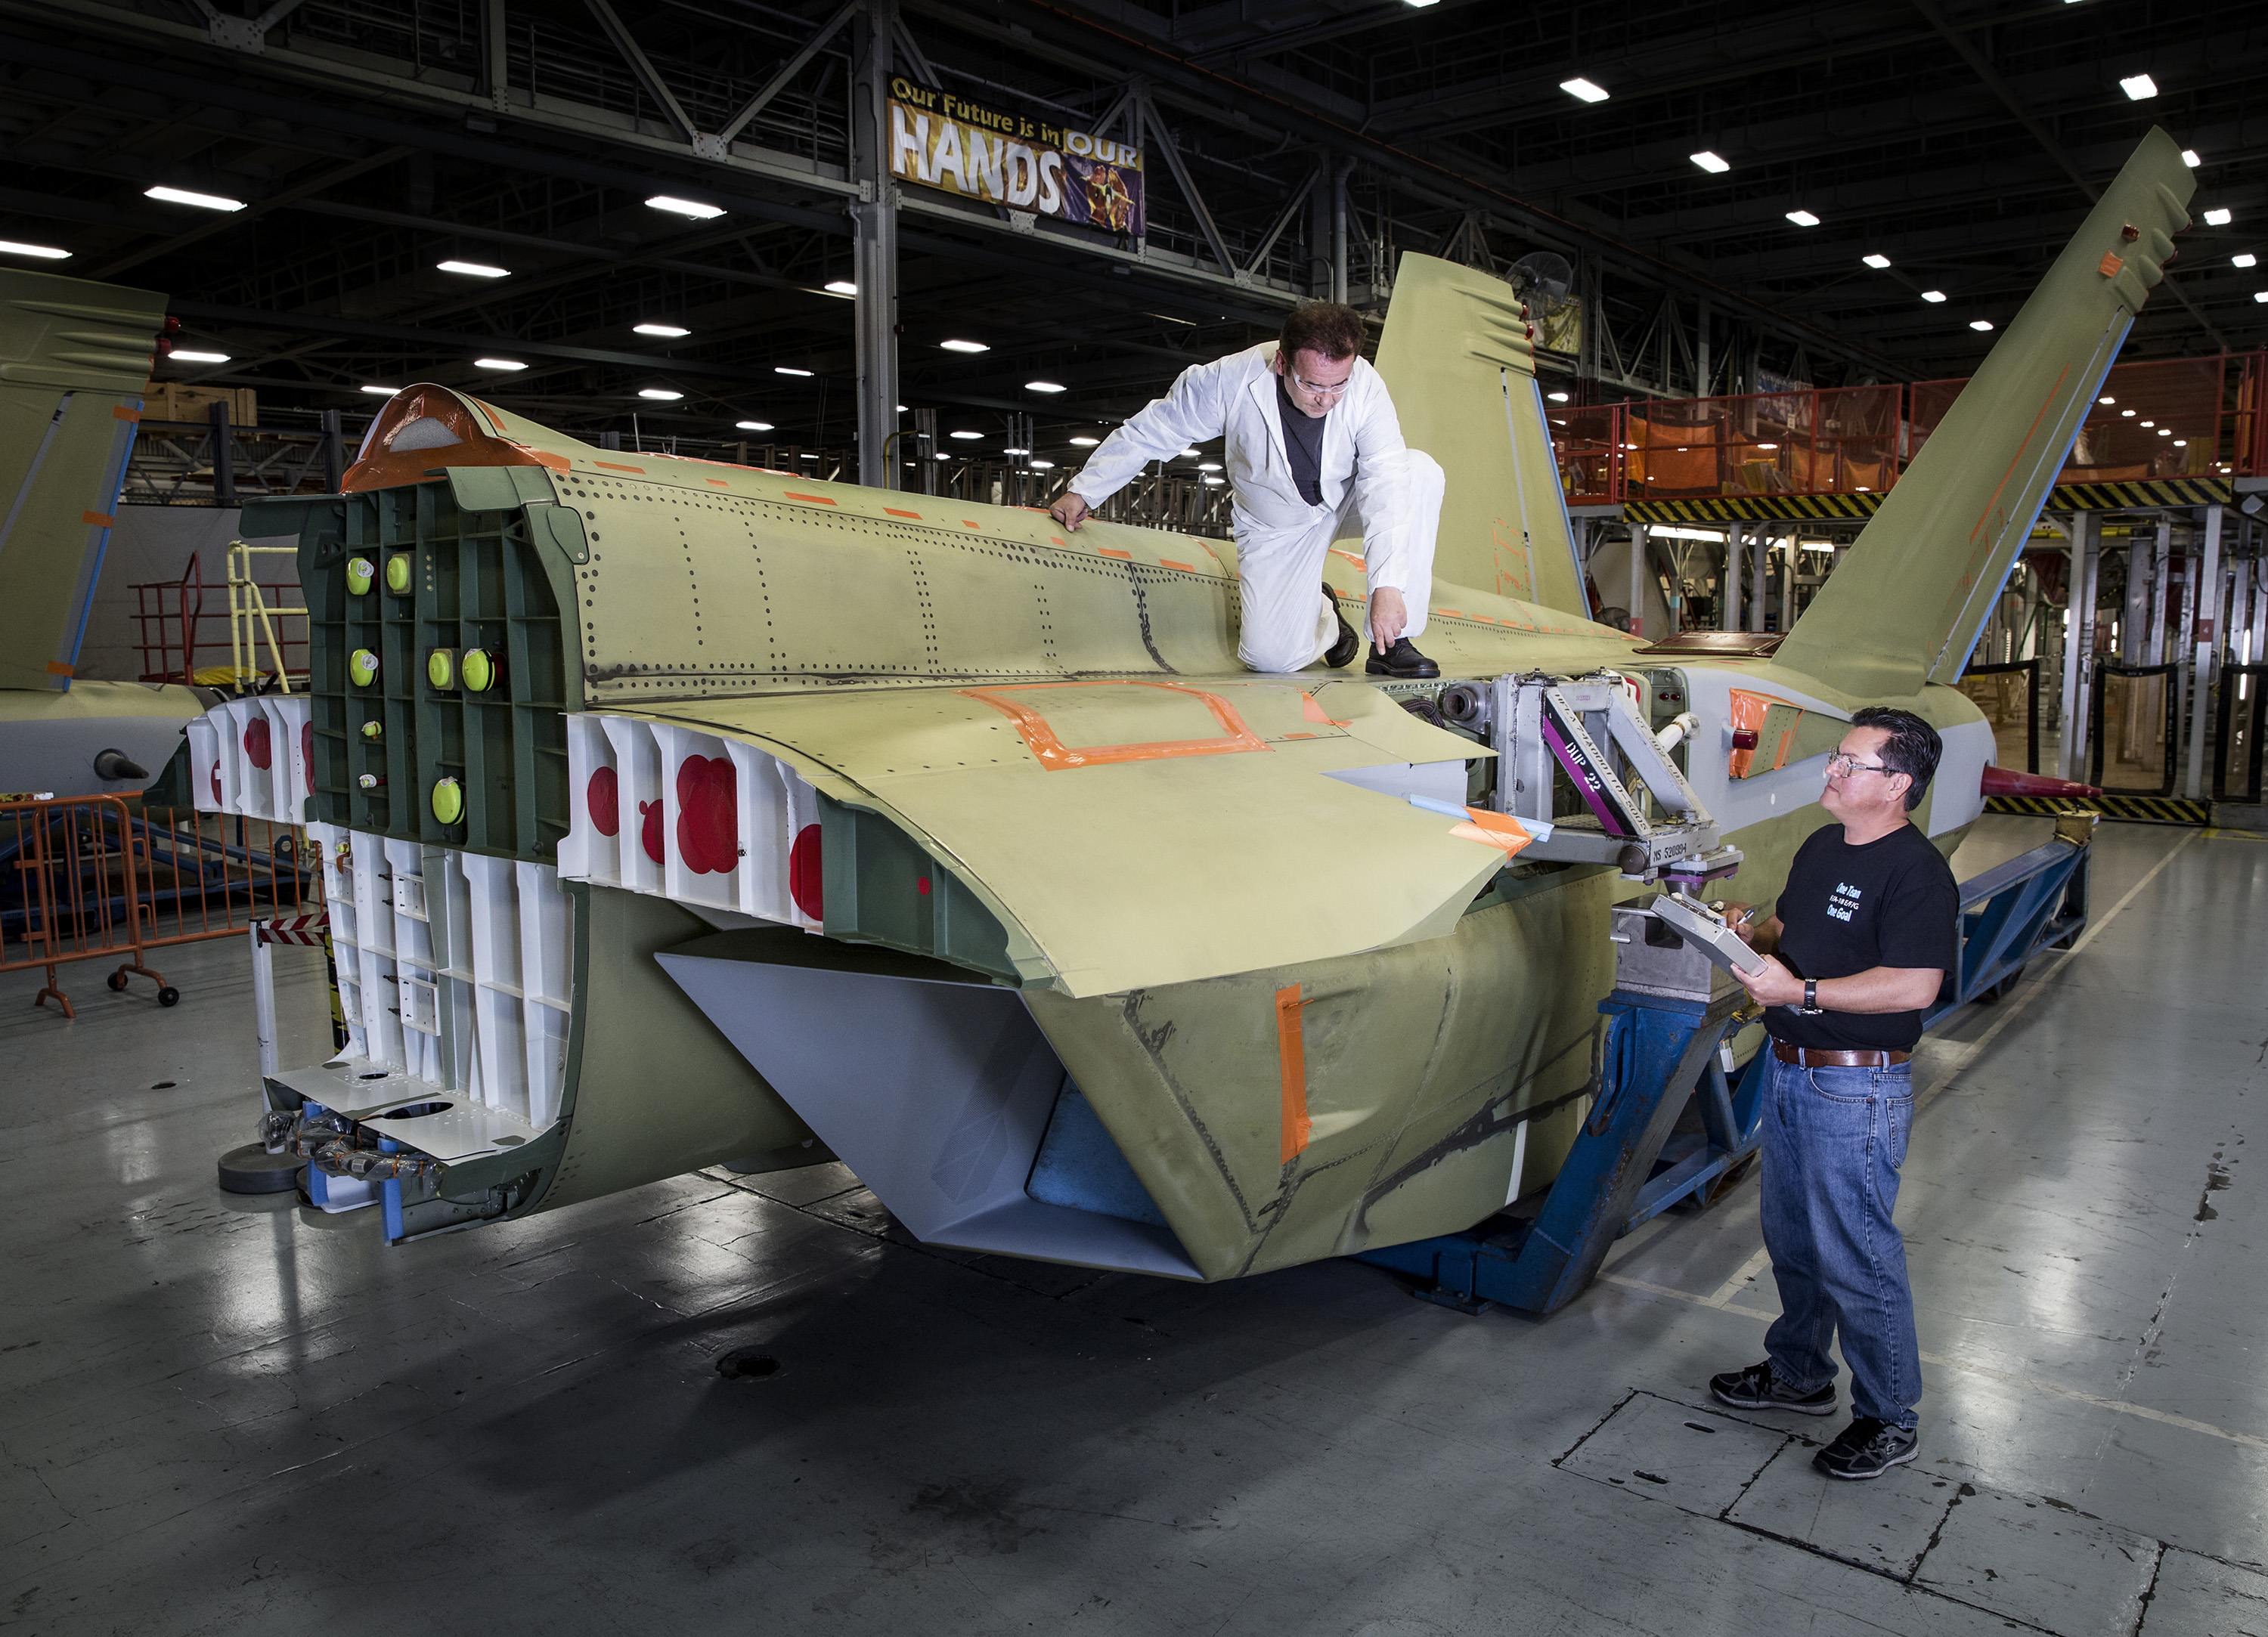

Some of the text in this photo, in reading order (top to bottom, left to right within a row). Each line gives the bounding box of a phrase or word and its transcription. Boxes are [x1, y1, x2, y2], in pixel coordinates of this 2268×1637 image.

[892, 78, 1137, 169] Our Future is in OUR
[892, 106, 1061, 214] HANDS
[1565, 741, 1601, 792] DUP 22
[1830, 895, 1860, 910] F/A-18 E/F/G
[1836, 882, 1862, 899] One Team
[1826, 904, 1852, 922] One Goal
